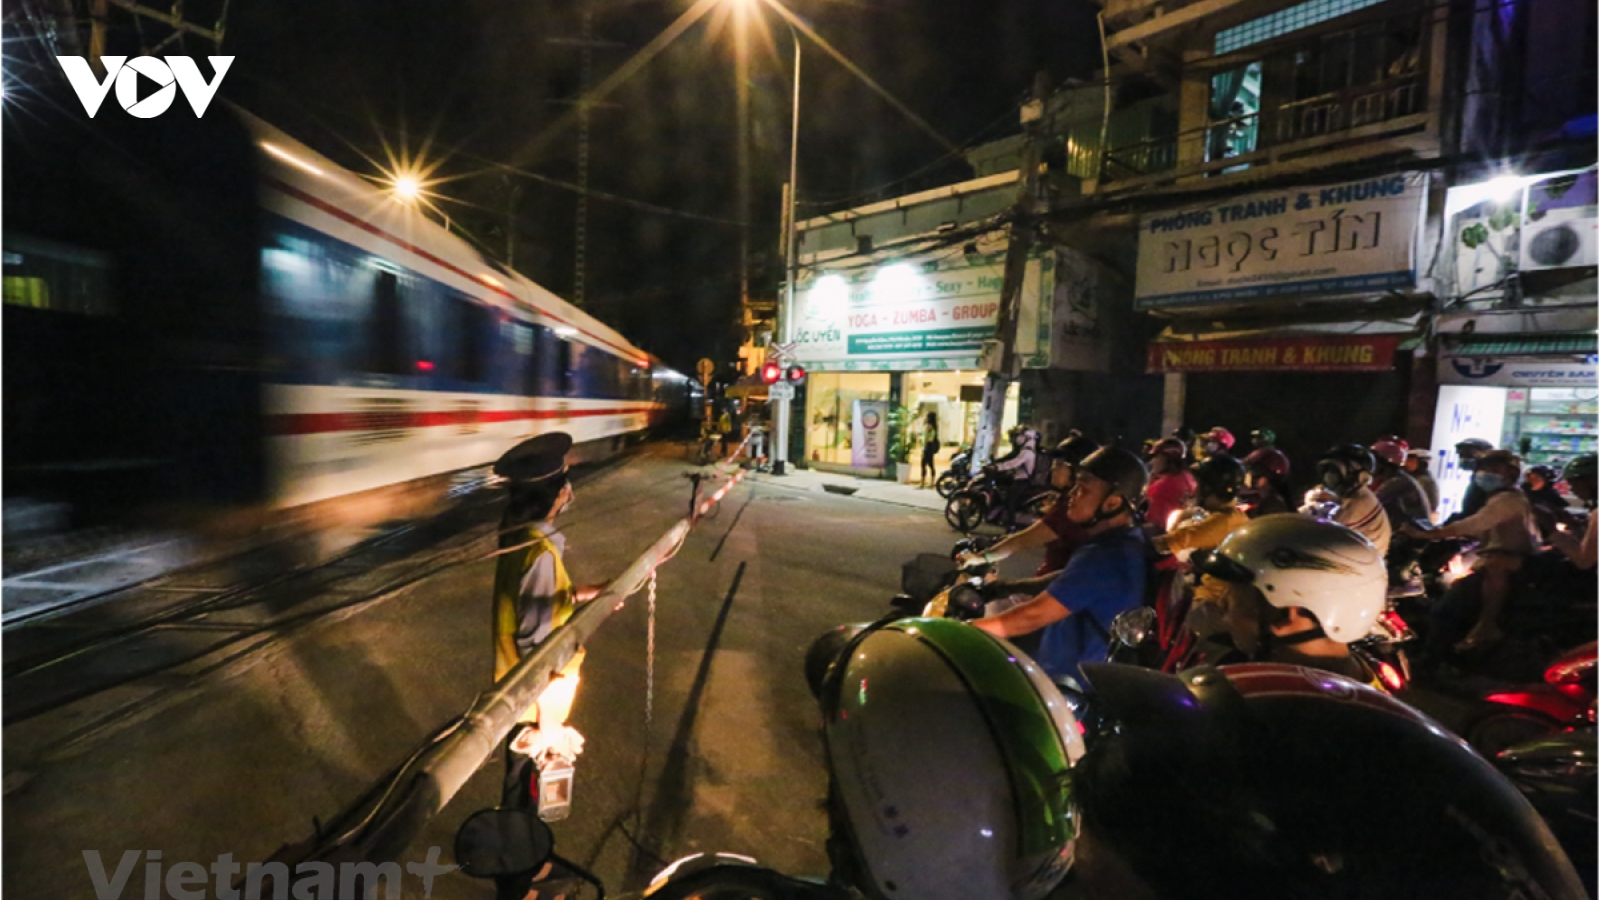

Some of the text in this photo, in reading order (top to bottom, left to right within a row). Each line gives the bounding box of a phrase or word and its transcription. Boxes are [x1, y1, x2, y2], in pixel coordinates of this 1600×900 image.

[1150, 177, 1405, 234] PHÒNG TRANH & KHUNG
[1292, 208, 1381, 256] TÍN
[936, 280, 962, 294] Sexy
[848, 313, 877, 328] YOGA
[893, 307, 937, 326] ZUMBA
[1221, 346, 1278, 365] TRANH
[1283, 345, 1297, 363] &
[1303, 344, 1373, 364] KHUNG
